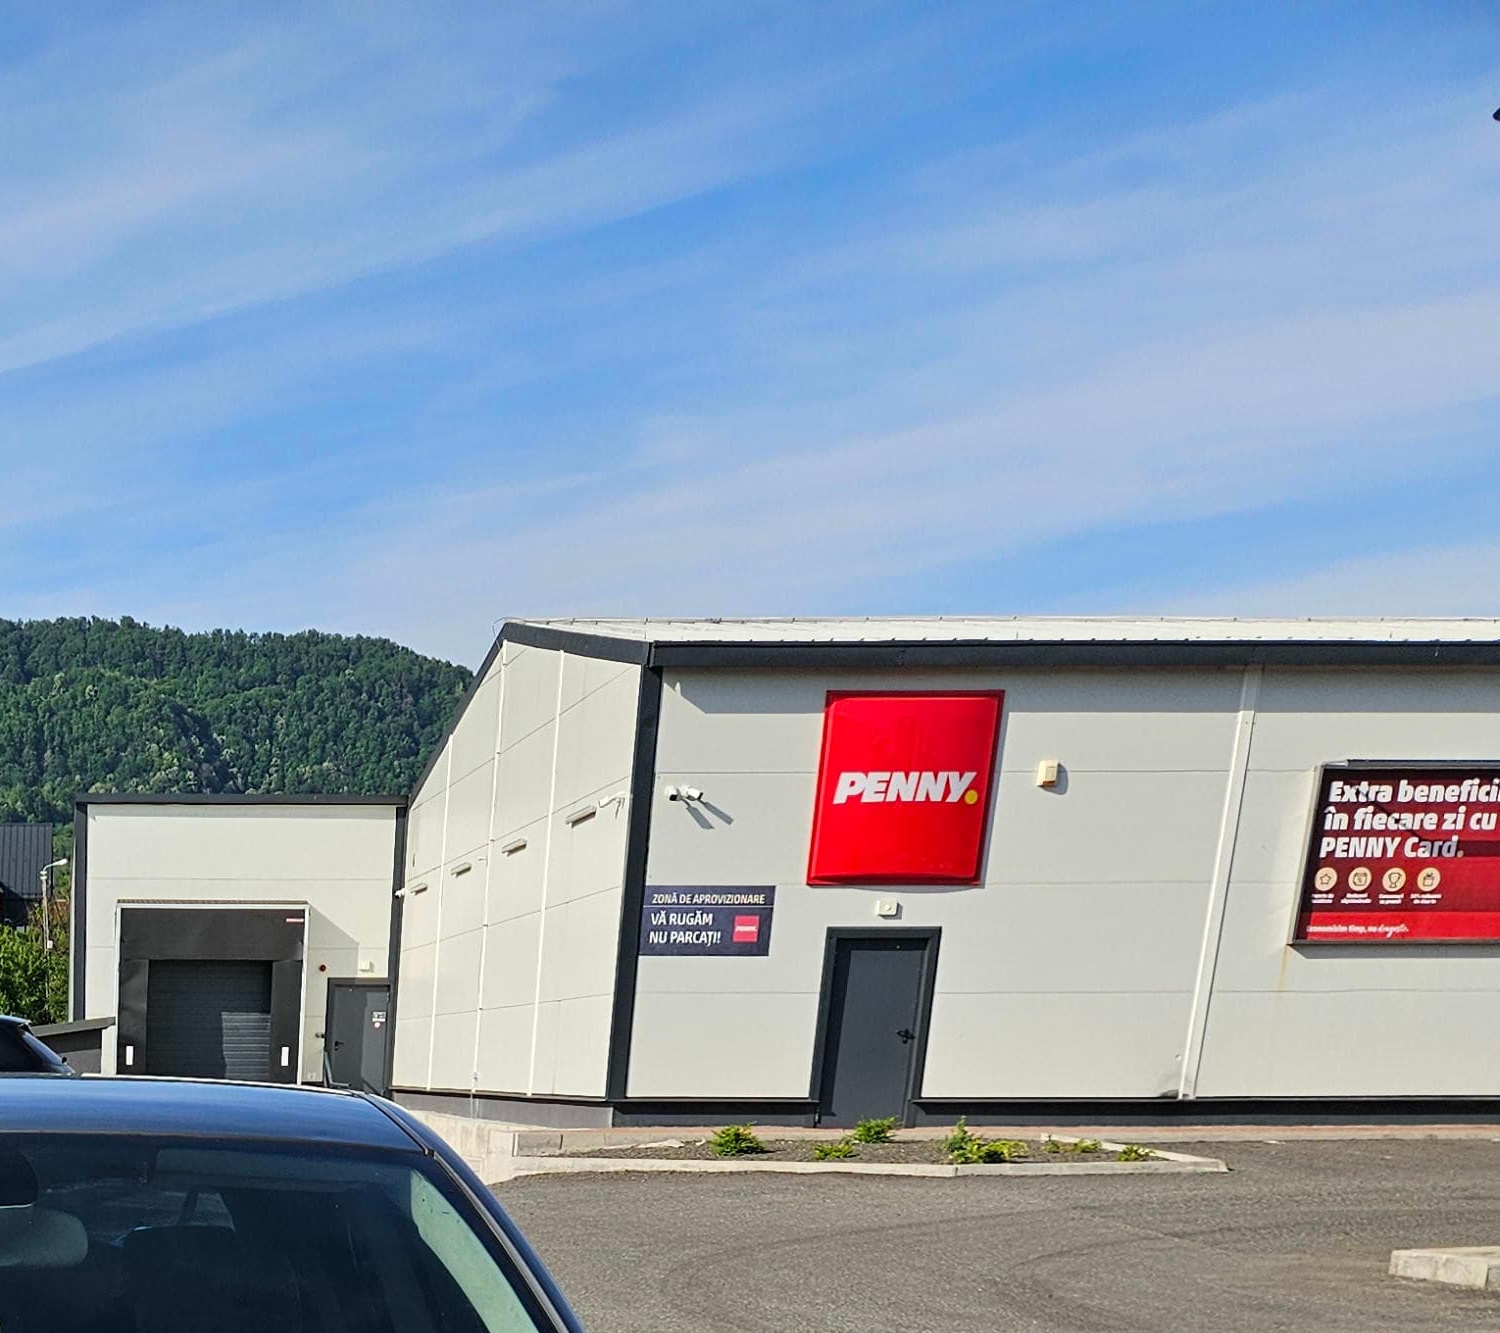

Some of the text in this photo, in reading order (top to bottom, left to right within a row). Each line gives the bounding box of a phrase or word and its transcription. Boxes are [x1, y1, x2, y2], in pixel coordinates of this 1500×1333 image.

[1329, 778, 1500, 803] Extra benefici
[1323, 805, 1497, 831] în fiecare zi cu
[1319, 835, 1464, 859] PENNY Card.
[652, 892, 766, 904] ZONĂ DE APROVIZIONARE
[651, 910, 713, 926] VĂ RUGĂM
[649, 931, 667, 943] NU
